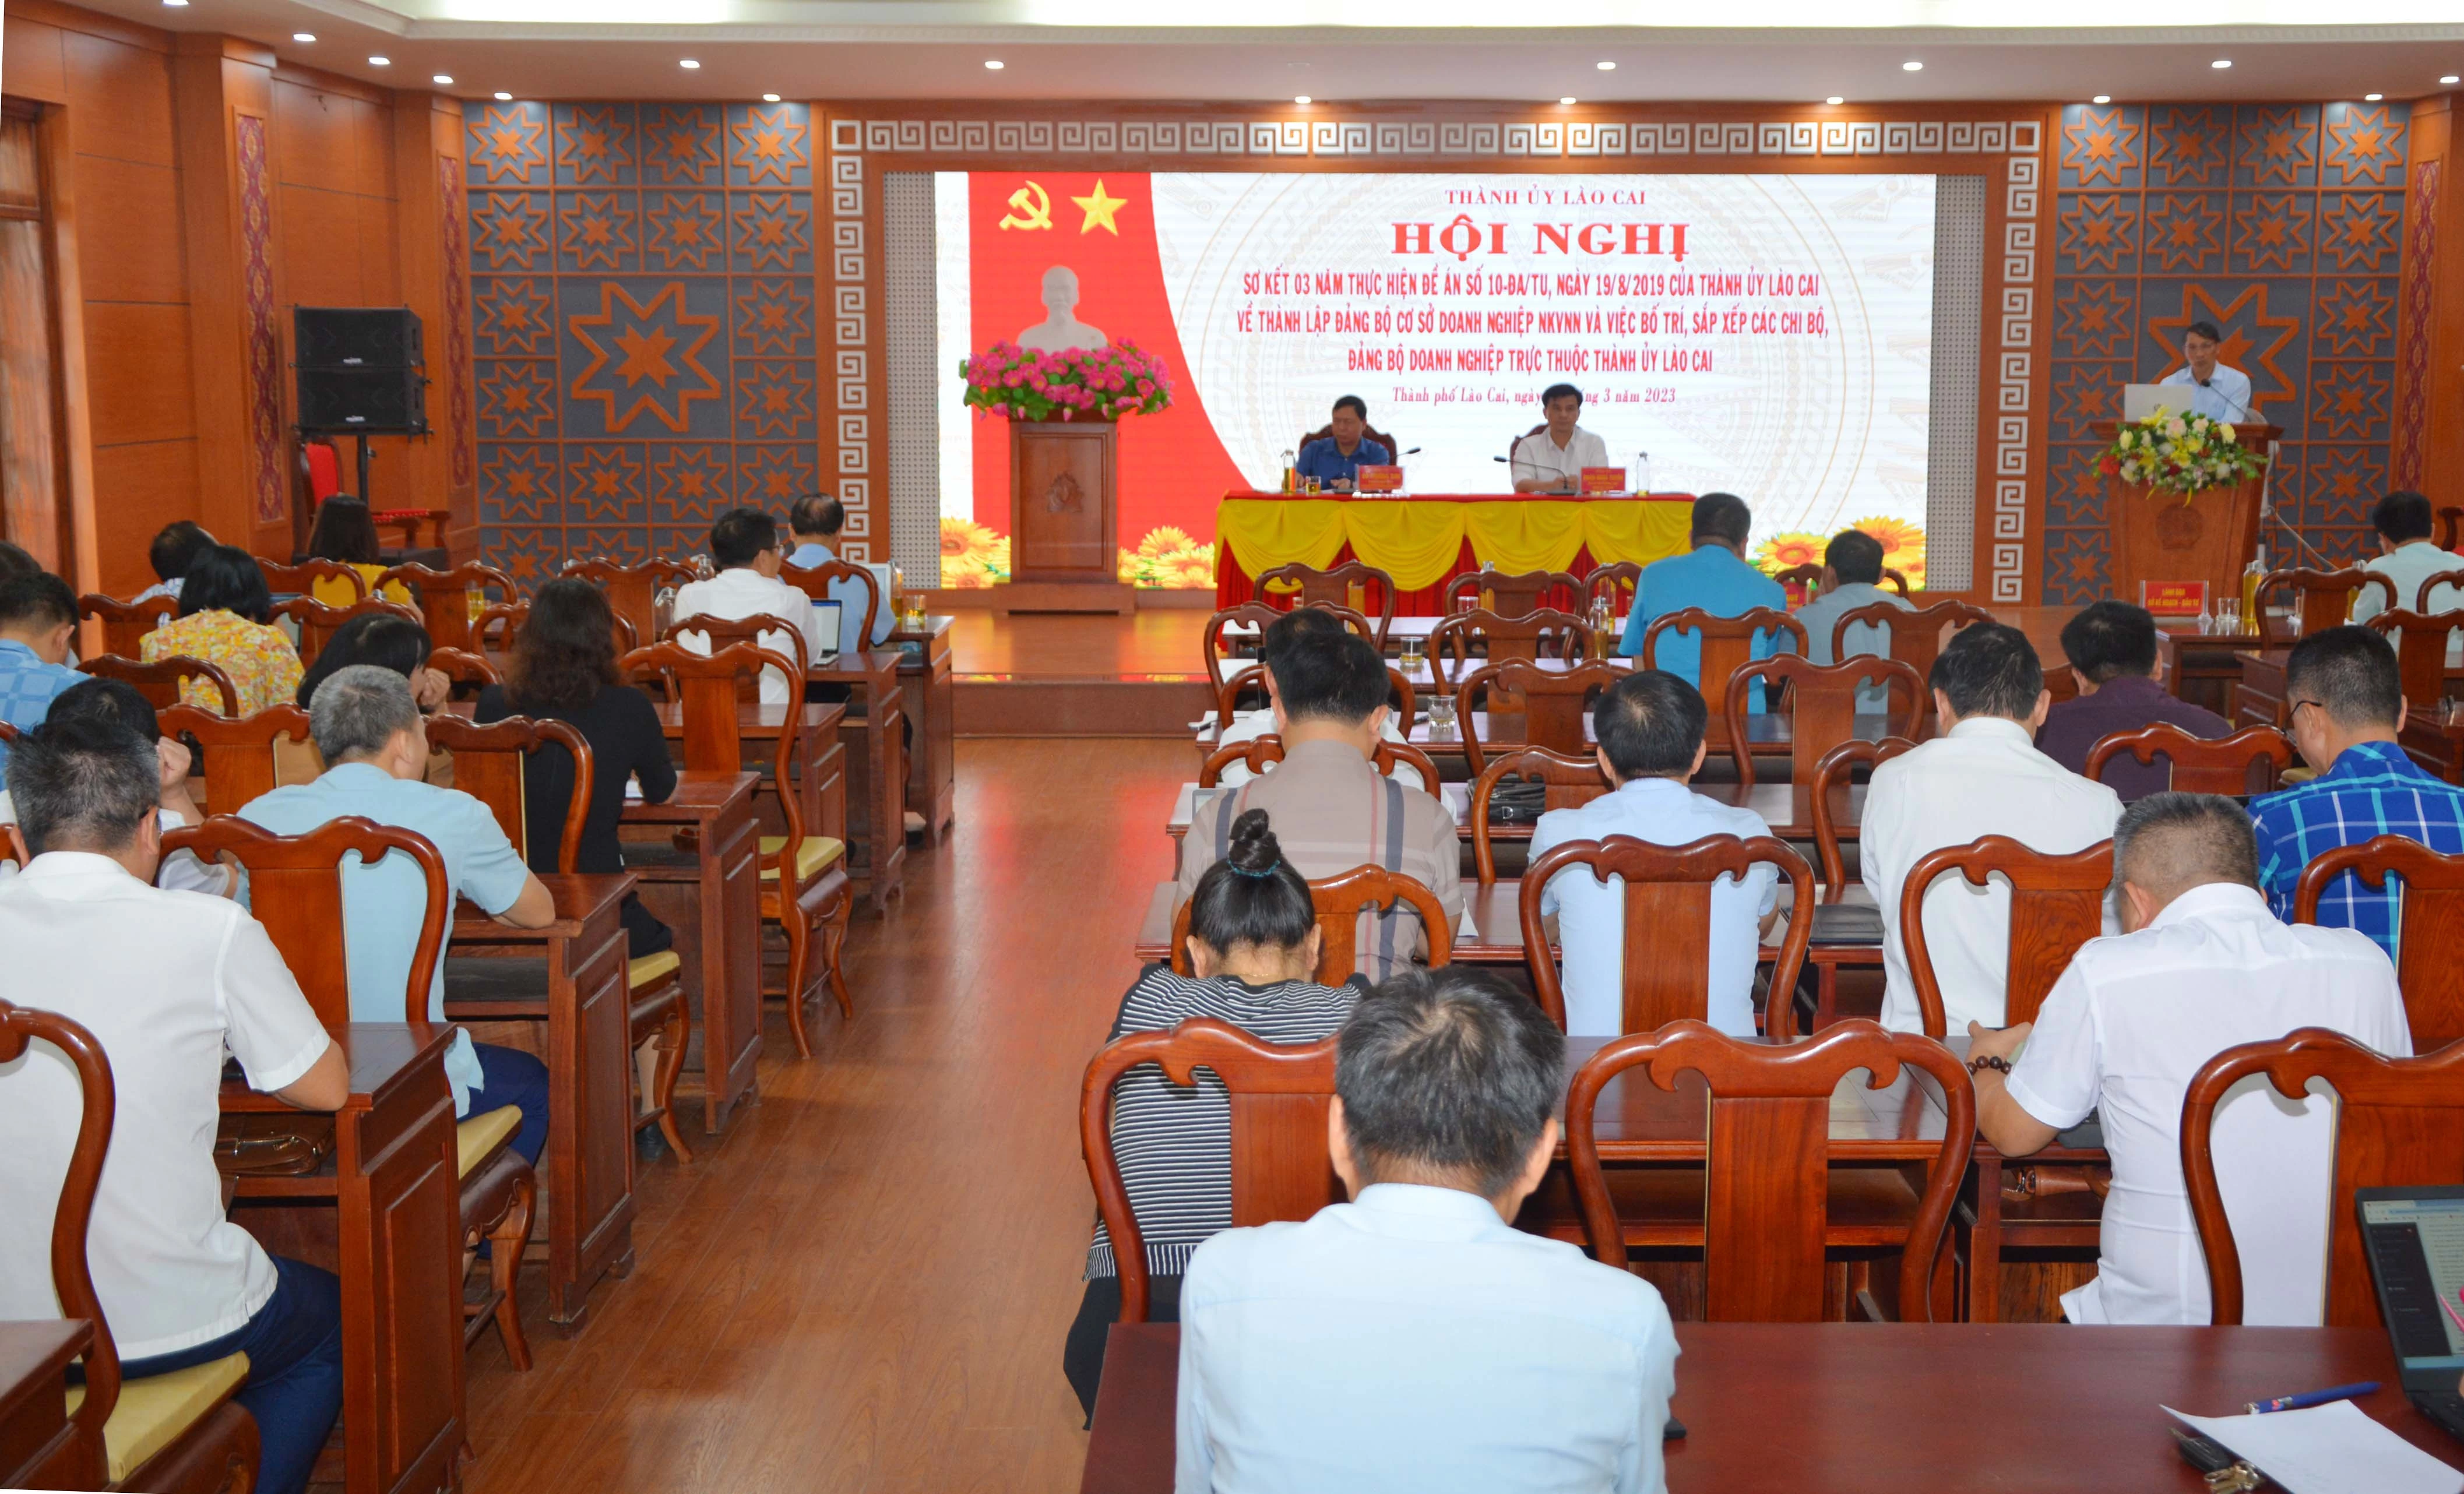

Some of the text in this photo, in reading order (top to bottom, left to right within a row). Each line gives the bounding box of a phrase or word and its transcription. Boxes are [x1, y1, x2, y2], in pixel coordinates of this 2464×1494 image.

[1445, 183, 1646, 205] THÀNH ỦY LÀO CAI
[1391, 212, 1689, 262] HỘI NGHỊ
[1244, 263, 1819, 301] SƠ KẾT 03 NĂM THỰC HIỆN ĐỀ ÁN SỐ 10-ĐA/TU, NGÀY 19/8/2019 CỦA THÀNH ỦY LÀO CAI
[1237, 299, 1829, 339] VỀ THÀNH LẬP ĐẢNG BỘ CƠ SỞ DOANH NGHIỆP NKVNN VÀ VIỆC BỐ TRÍ, SẮP XẾP CÁC CHI BỘ,
[1348, 340, 1713, 376] ĐẢNG BỘ DOANH NGHIỆP TRỰC THUỘC THÀNH ỦY LÀO CAI
[1393, 386, 1430, 403] Thành
[1434, 385, 1458, 406] phố
[1461, 386, 1483, 403] Lào
[1487, 386, 1510, 404] Cai,
[1515, 387, 1542, 406] ngày
[1603, 387, 1611, 403] 3
[1615, 388, 1640, 403] năm
[1643, 387, 1676, 403] 2023
